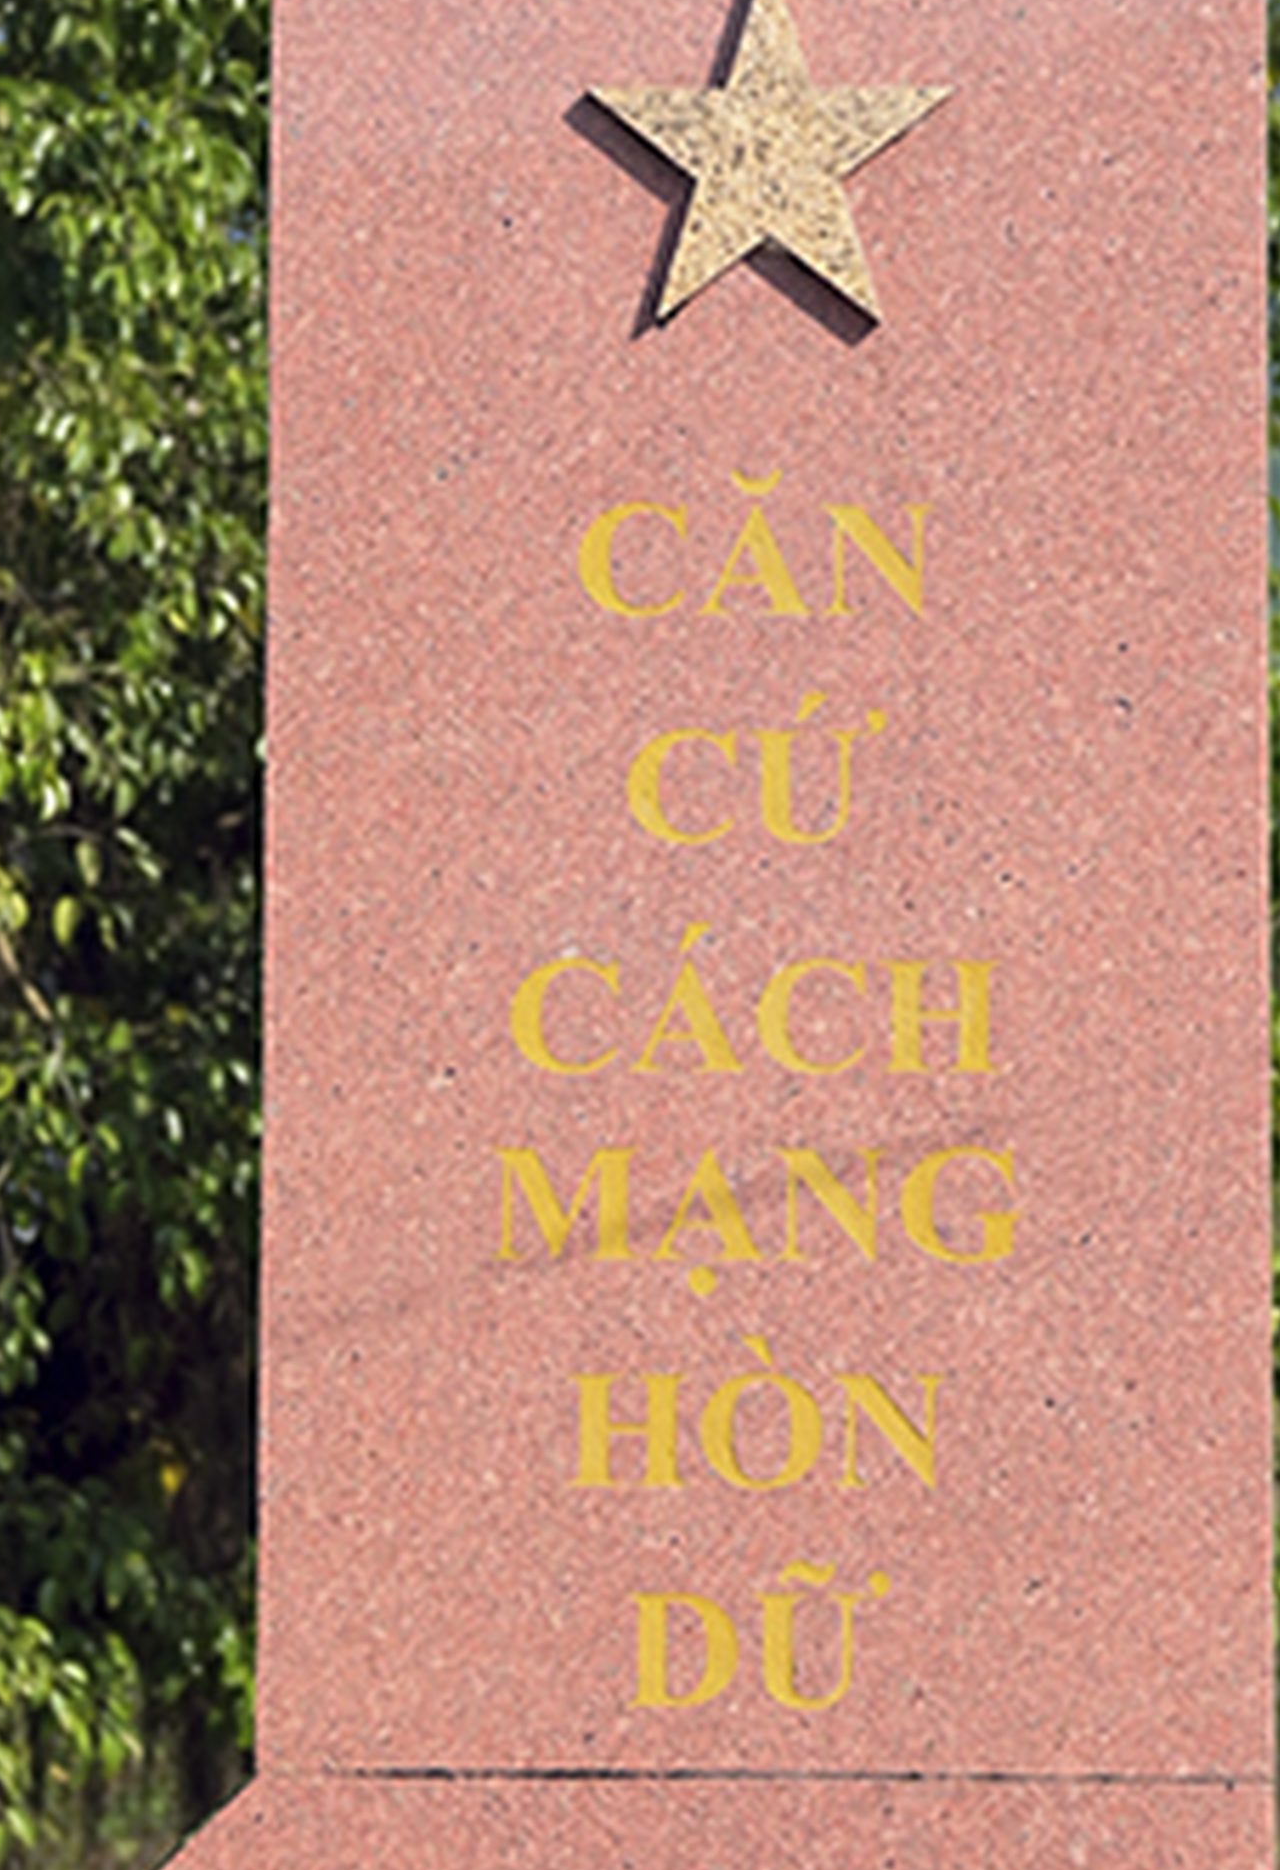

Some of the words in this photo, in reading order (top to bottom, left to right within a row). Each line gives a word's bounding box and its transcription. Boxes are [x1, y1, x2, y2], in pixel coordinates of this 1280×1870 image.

[576, 468, 936, 619] CĂN
[625, 690, 889, 846] CỨ
[508, 920, 1000, 1076] CÁCH
[491, 1144, 1023, 1297] MẠNG
[568, 1333, 945, 1492] HÒN
[627, 1558, 892, 1711] DỮ
